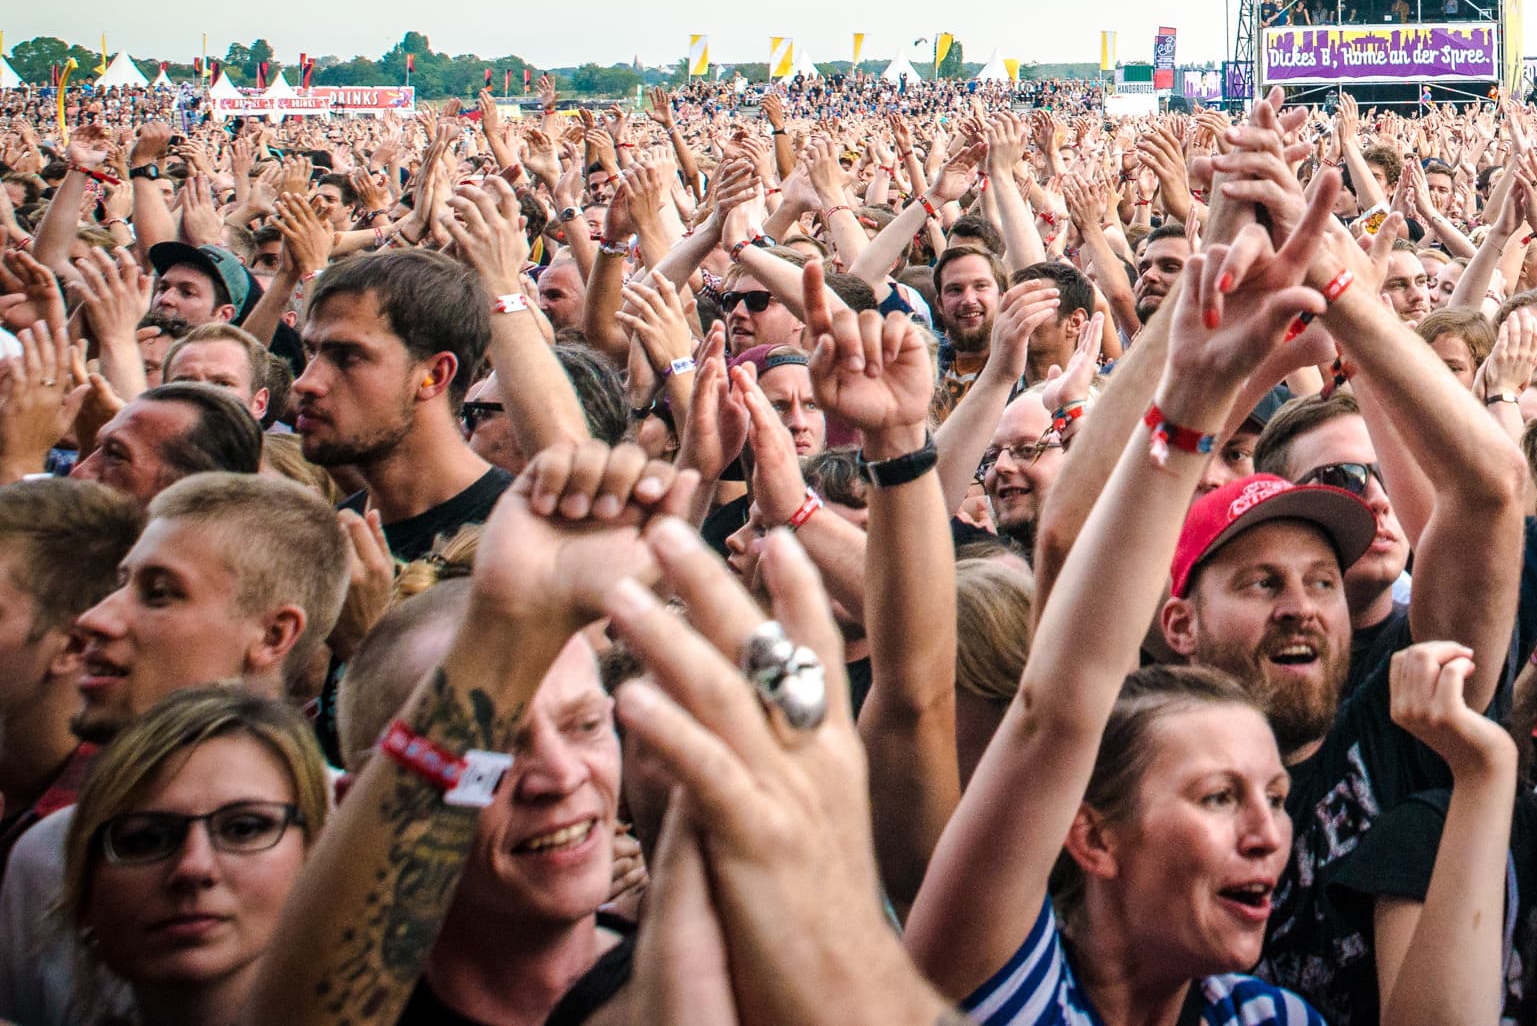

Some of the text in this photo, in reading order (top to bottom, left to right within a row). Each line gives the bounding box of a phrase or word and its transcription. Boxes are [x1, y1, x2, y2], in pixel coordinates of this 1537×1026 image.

[1268, 44, 1316, 67] Dickes
[1340, 47, 1388, 67] Home
[1389, 49, 1411, 65] an
[1412, 46, 1440, 65] der
[330, 90, 379, 106] DRINKS
